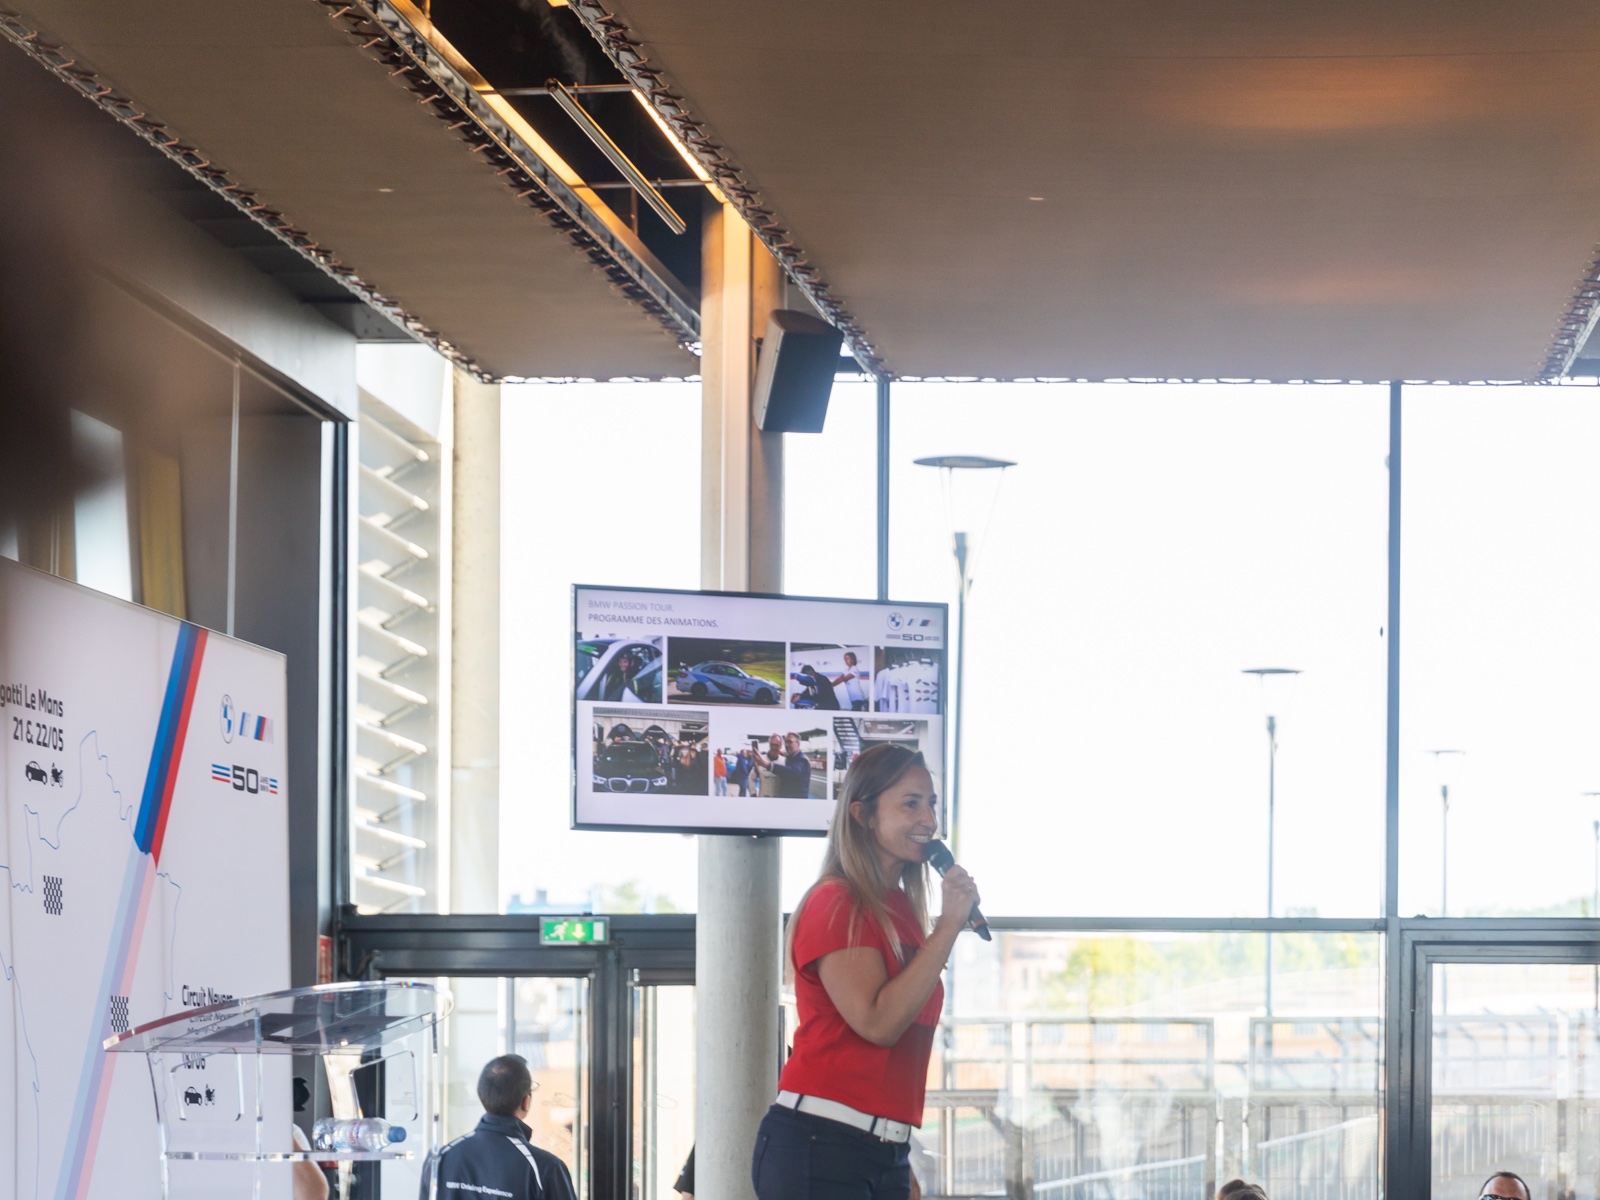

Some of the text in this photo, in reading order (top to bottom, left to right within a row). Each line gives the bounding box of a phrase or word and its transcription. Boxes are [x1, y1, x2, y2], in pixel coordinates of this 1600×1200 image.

[588, 600, 674, 612] BMW PASSION TOUR.
[588, 613, 718, 628] PROGRAMME DES ANIMATIONS.
[902, 633, 924, 641] 50
[24, 684, 36, 711] Le
[38, 688, 64, 717] Mans
[12, 716, 64, 752] 21 & 22/05
[232, 764, 259, 794] 50
[182, 984, 206, 1008] Circuit
[460, 1182, 482, 1194] Driving
[482, 1185, 513, 1198] Experience
